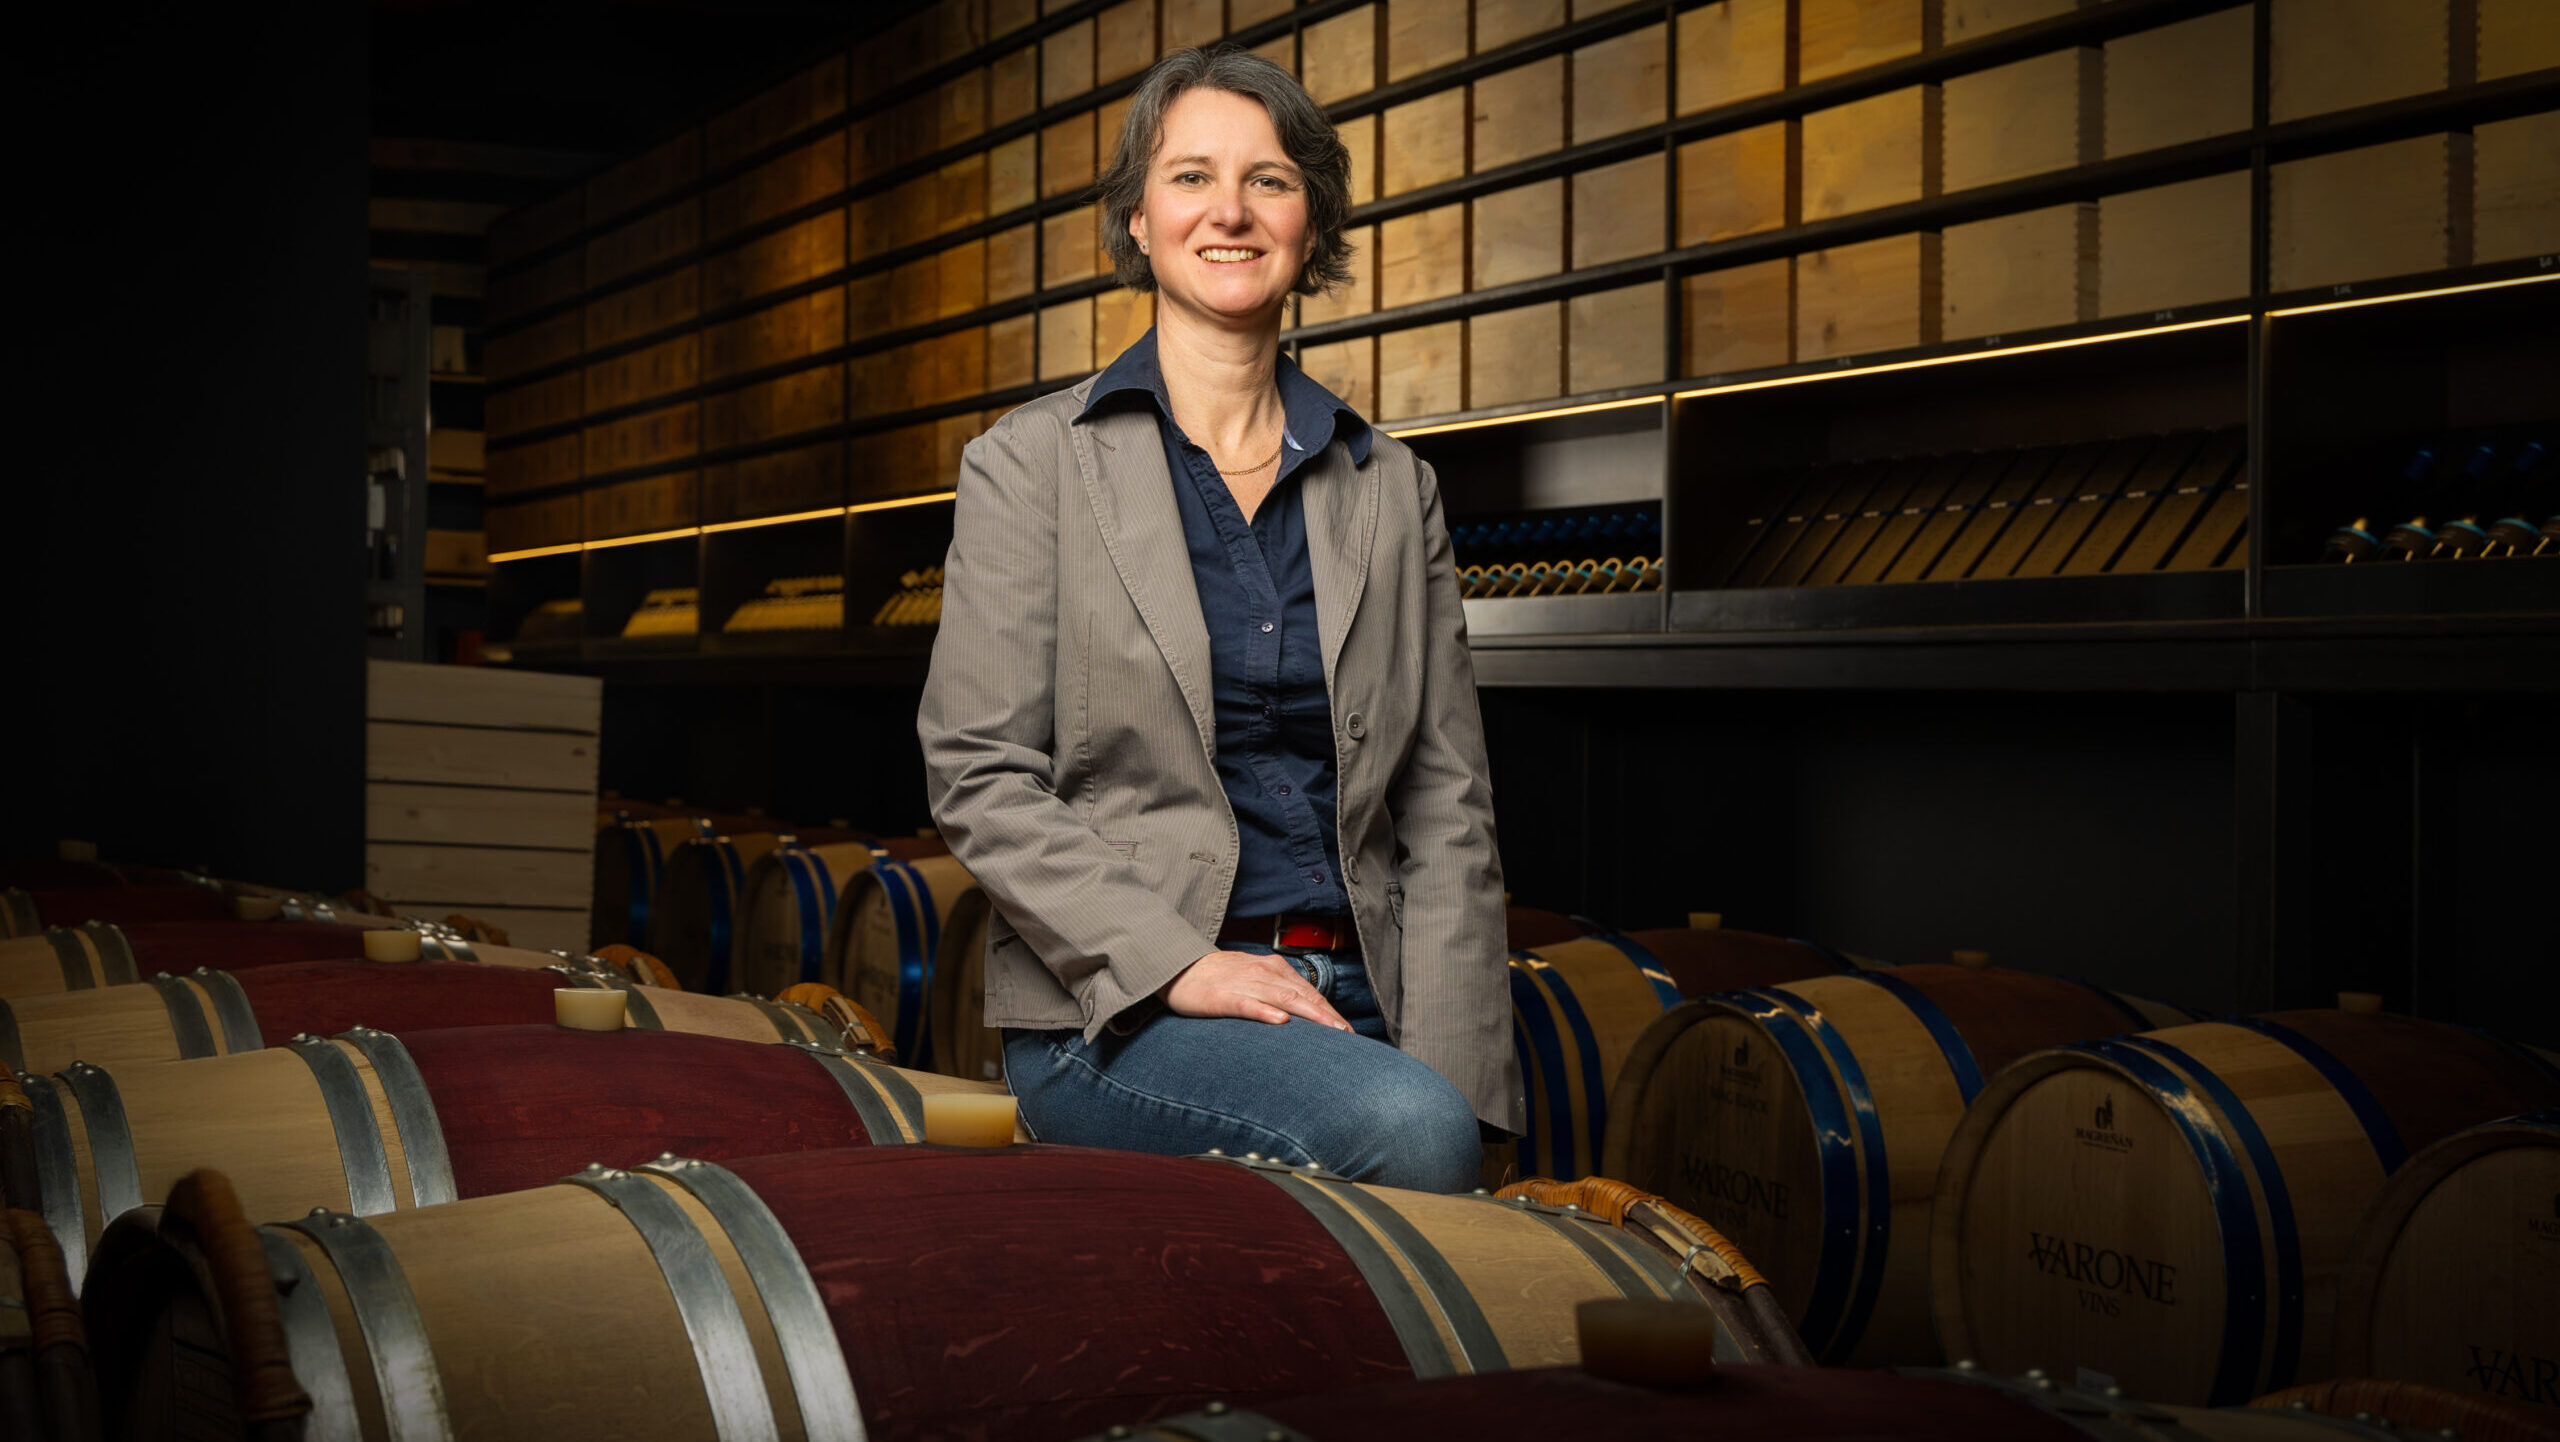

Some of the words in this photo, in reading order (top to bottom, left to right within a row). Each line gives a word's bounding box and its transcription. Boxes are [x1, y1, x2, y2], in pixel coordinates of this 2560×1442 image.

[1680, 1150, 1791, 1220] VARONE
[2028, 1231, 2176, 1306] VARONE
[2078, 1289, 2121, 1319] VINS
